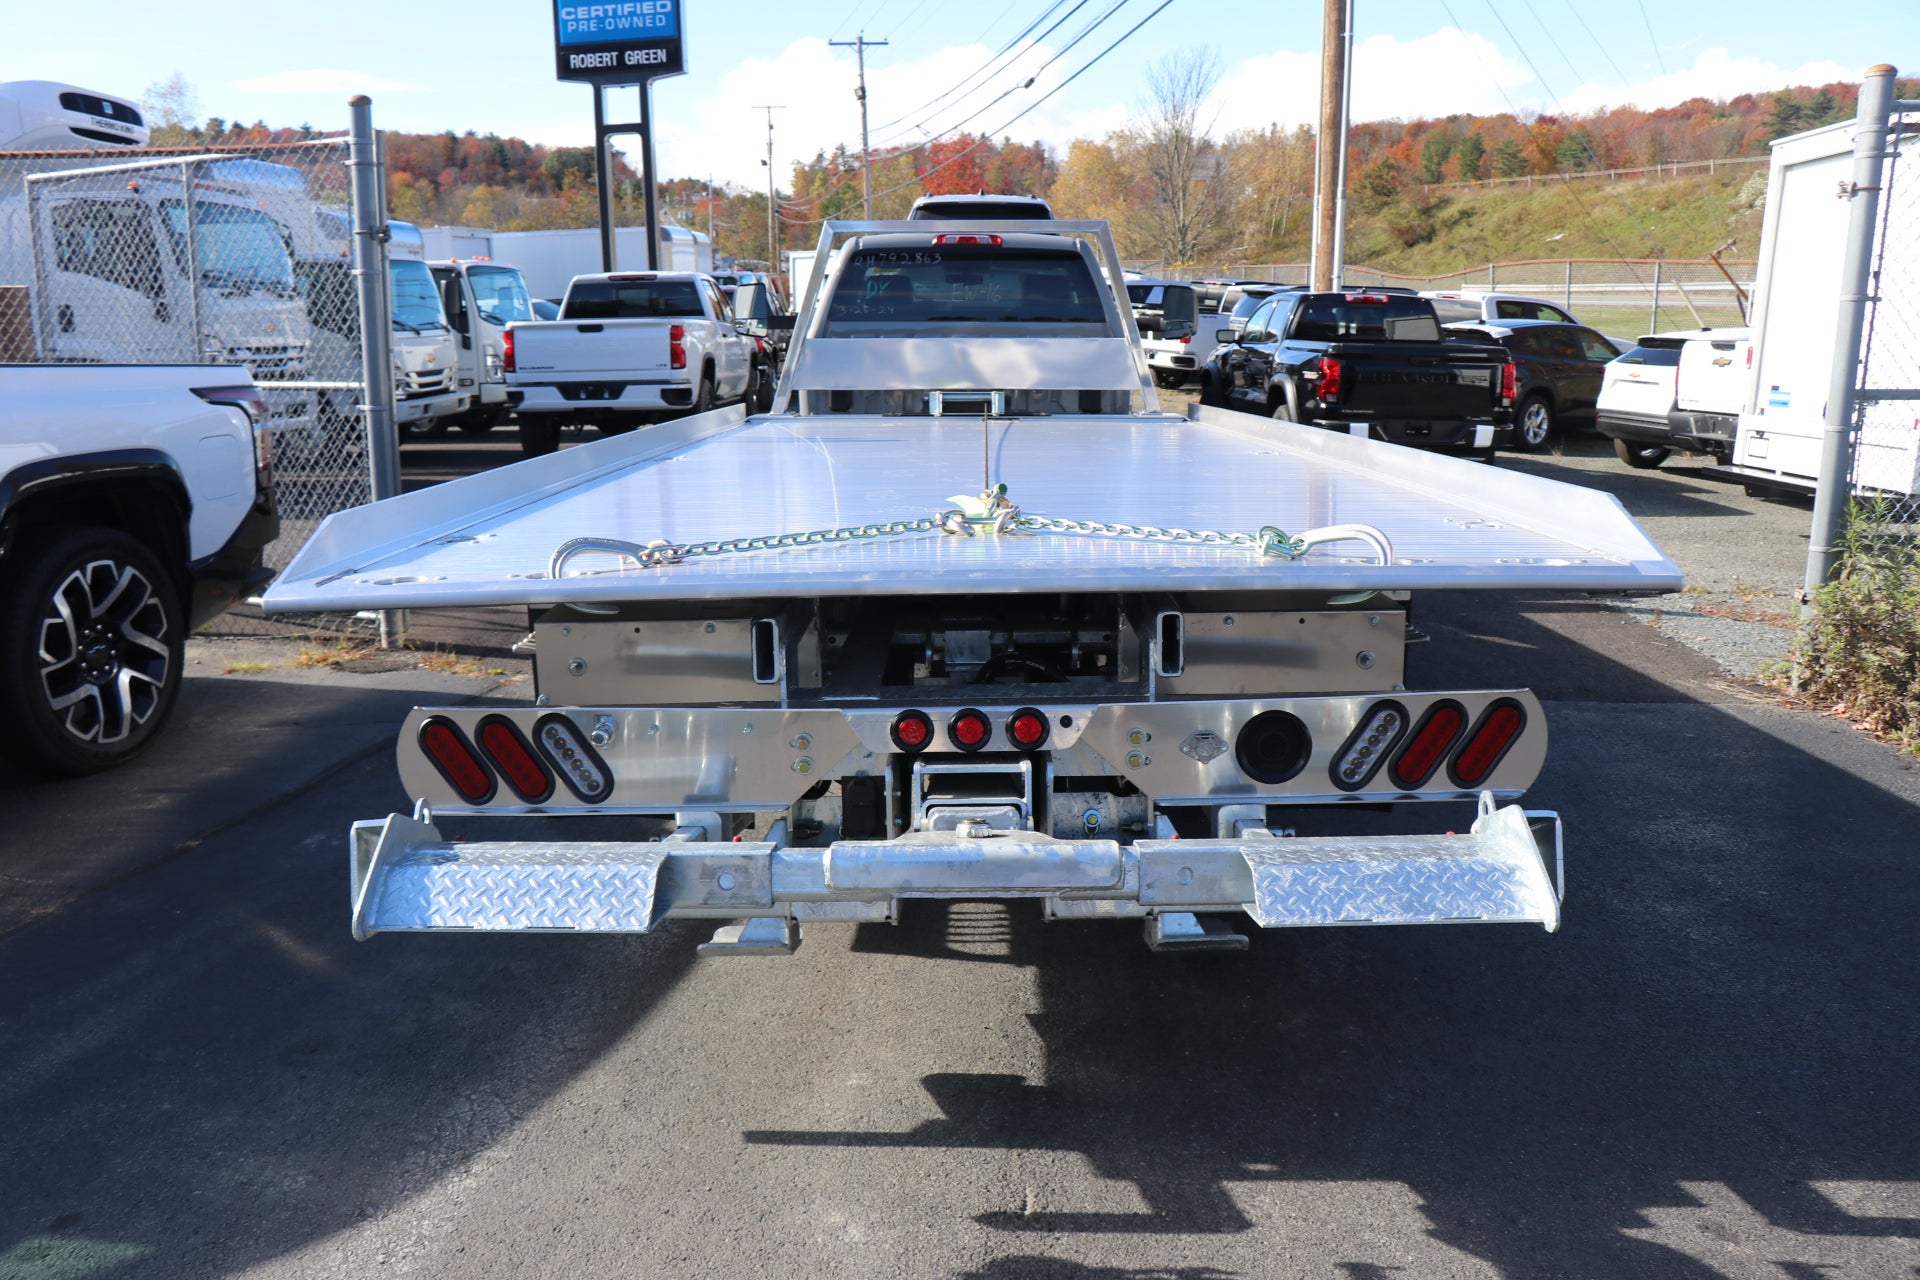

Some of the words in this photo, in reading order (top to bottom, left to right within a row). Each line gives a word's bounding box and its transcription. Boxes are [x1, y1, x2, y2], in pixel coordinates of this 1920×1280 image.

[561, 0, 672, 20] CERTIFIED
[567, 14, 666, 32] PRE-OWNED
[570, 51, 619, 69] ROBERT
[624, 48, 667, 65] GREEN
